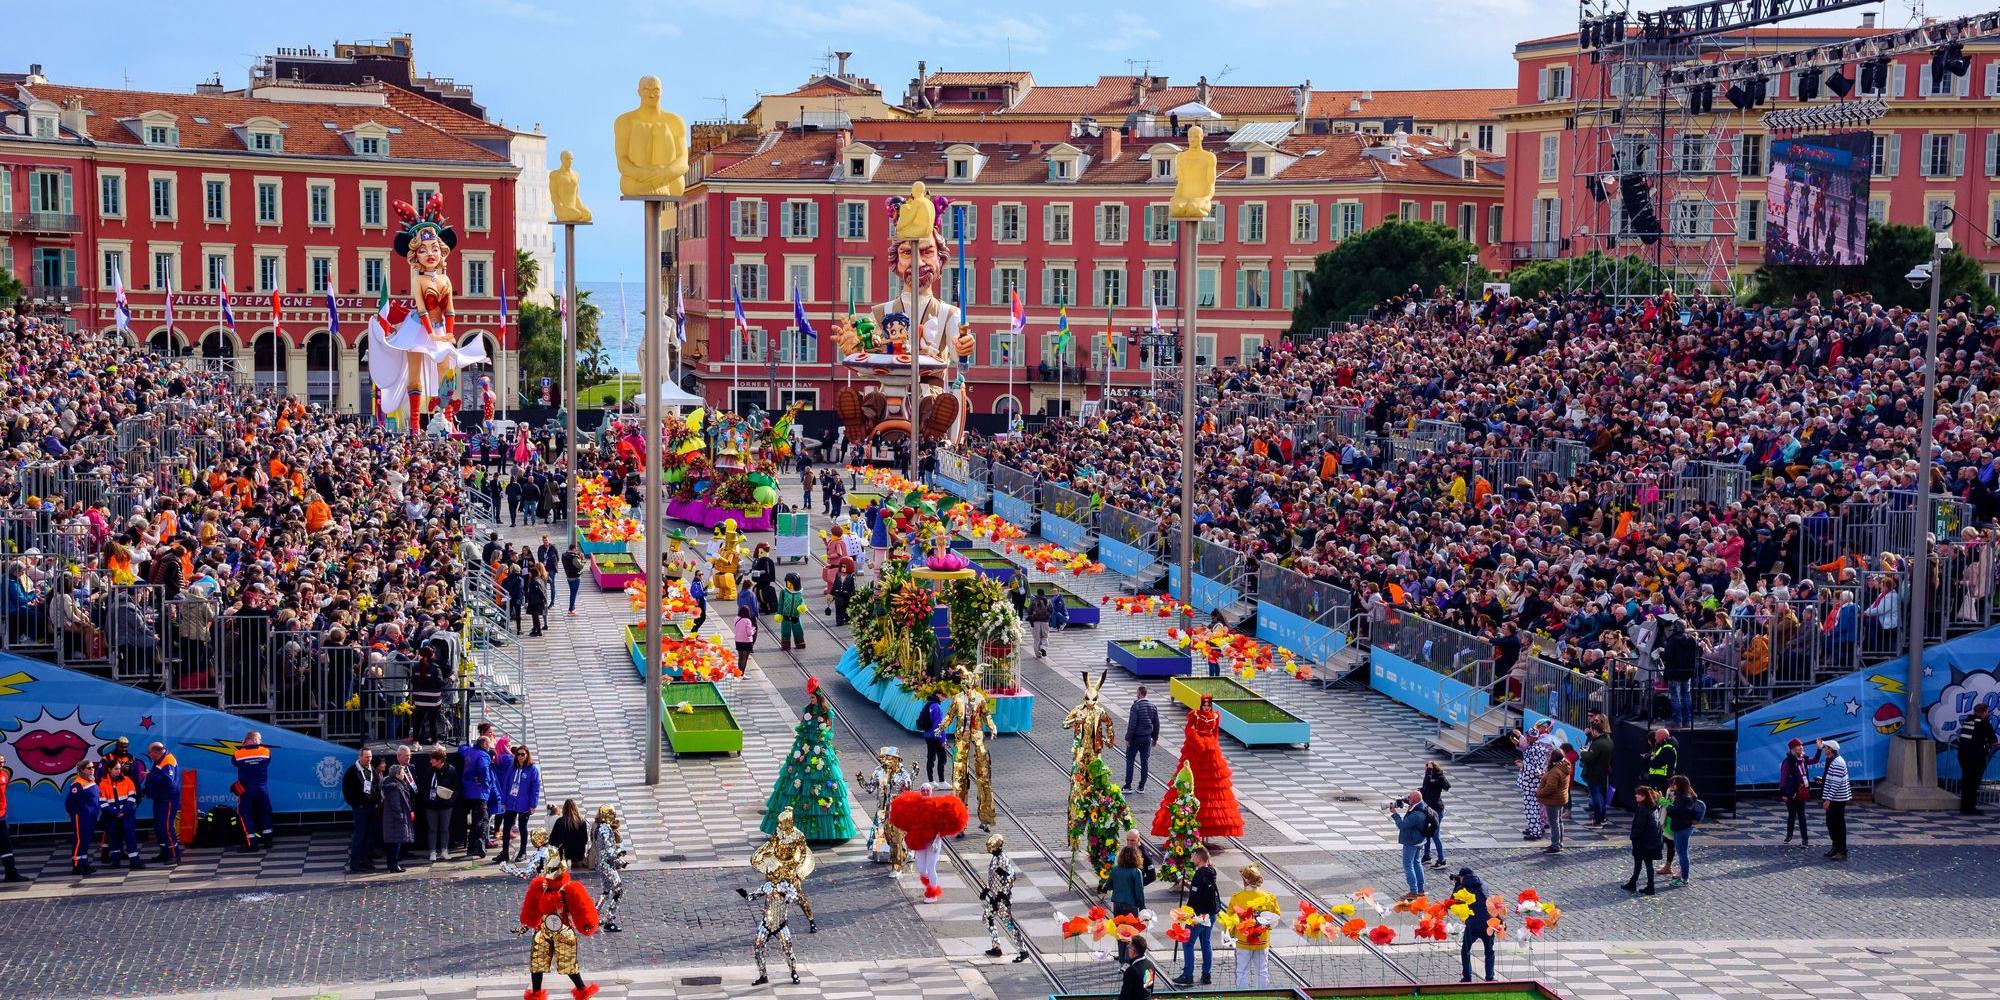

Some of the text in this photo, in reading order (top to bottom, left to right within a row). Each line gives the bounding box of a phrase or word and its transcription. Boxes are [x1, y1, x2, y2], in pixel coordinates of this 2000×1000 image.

[171, 295, 217, 305] AISSE
[229, 296, 313, 306] D'EPAGNE
[335, 298, 363, 308] OTE
[1956, 690, 1978, 713] 17
[198, 795, 239, 803] arnava
